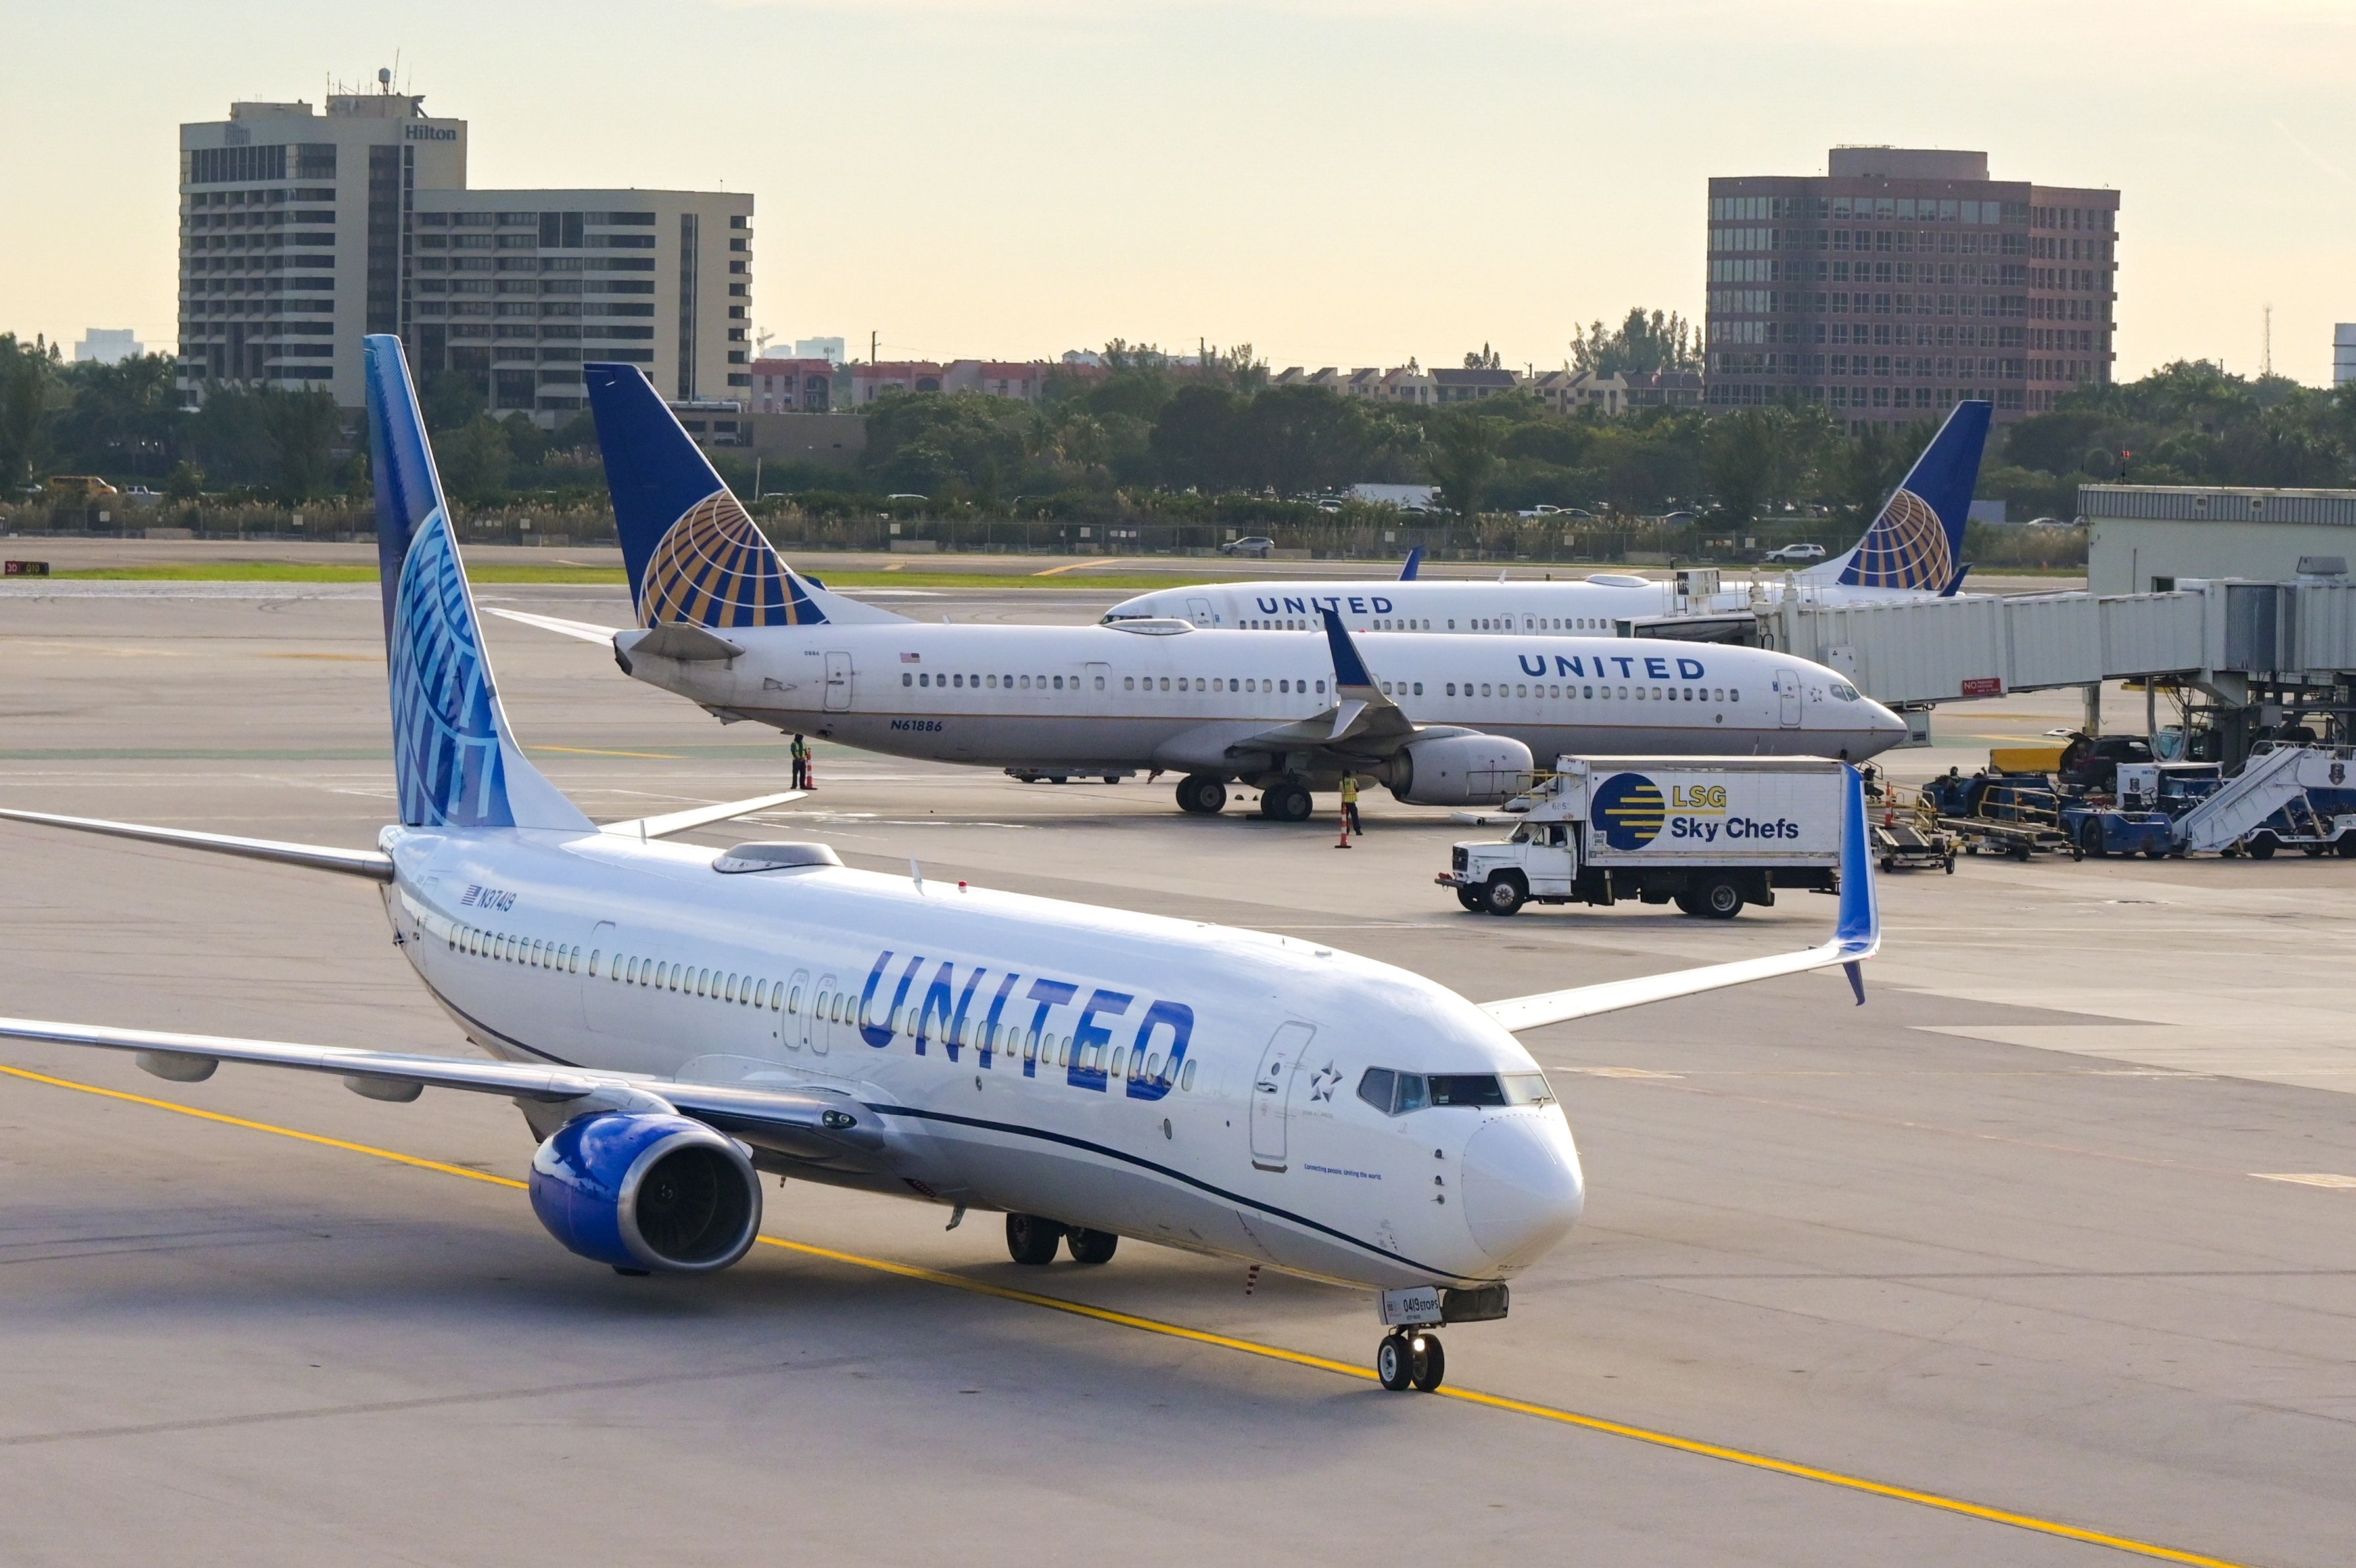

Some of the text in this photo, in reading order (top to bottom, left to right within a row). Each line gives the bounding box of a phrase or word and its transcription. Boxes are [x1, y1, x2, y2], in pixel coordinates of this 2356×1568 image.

[406, 125, 456, 140] Hilton
[1256, 597, 1392, 614] UNITED
[1518, 655, 1705, 680] UNITED
[891, 720, 942, 731] N61886
[1672, 785, 1726, 807] LSG
[1671, 817, 1799, 842] Sky Chefs
[477, 888, 517, 912] N37419
[859, 950, 1194, 1101] UNITED
[1304, 1163, 1327, 1173] Connecting
[1403, 1297, 1420, 1312] 0419
[1420, 1299, 1438, 1311] ETOPS
